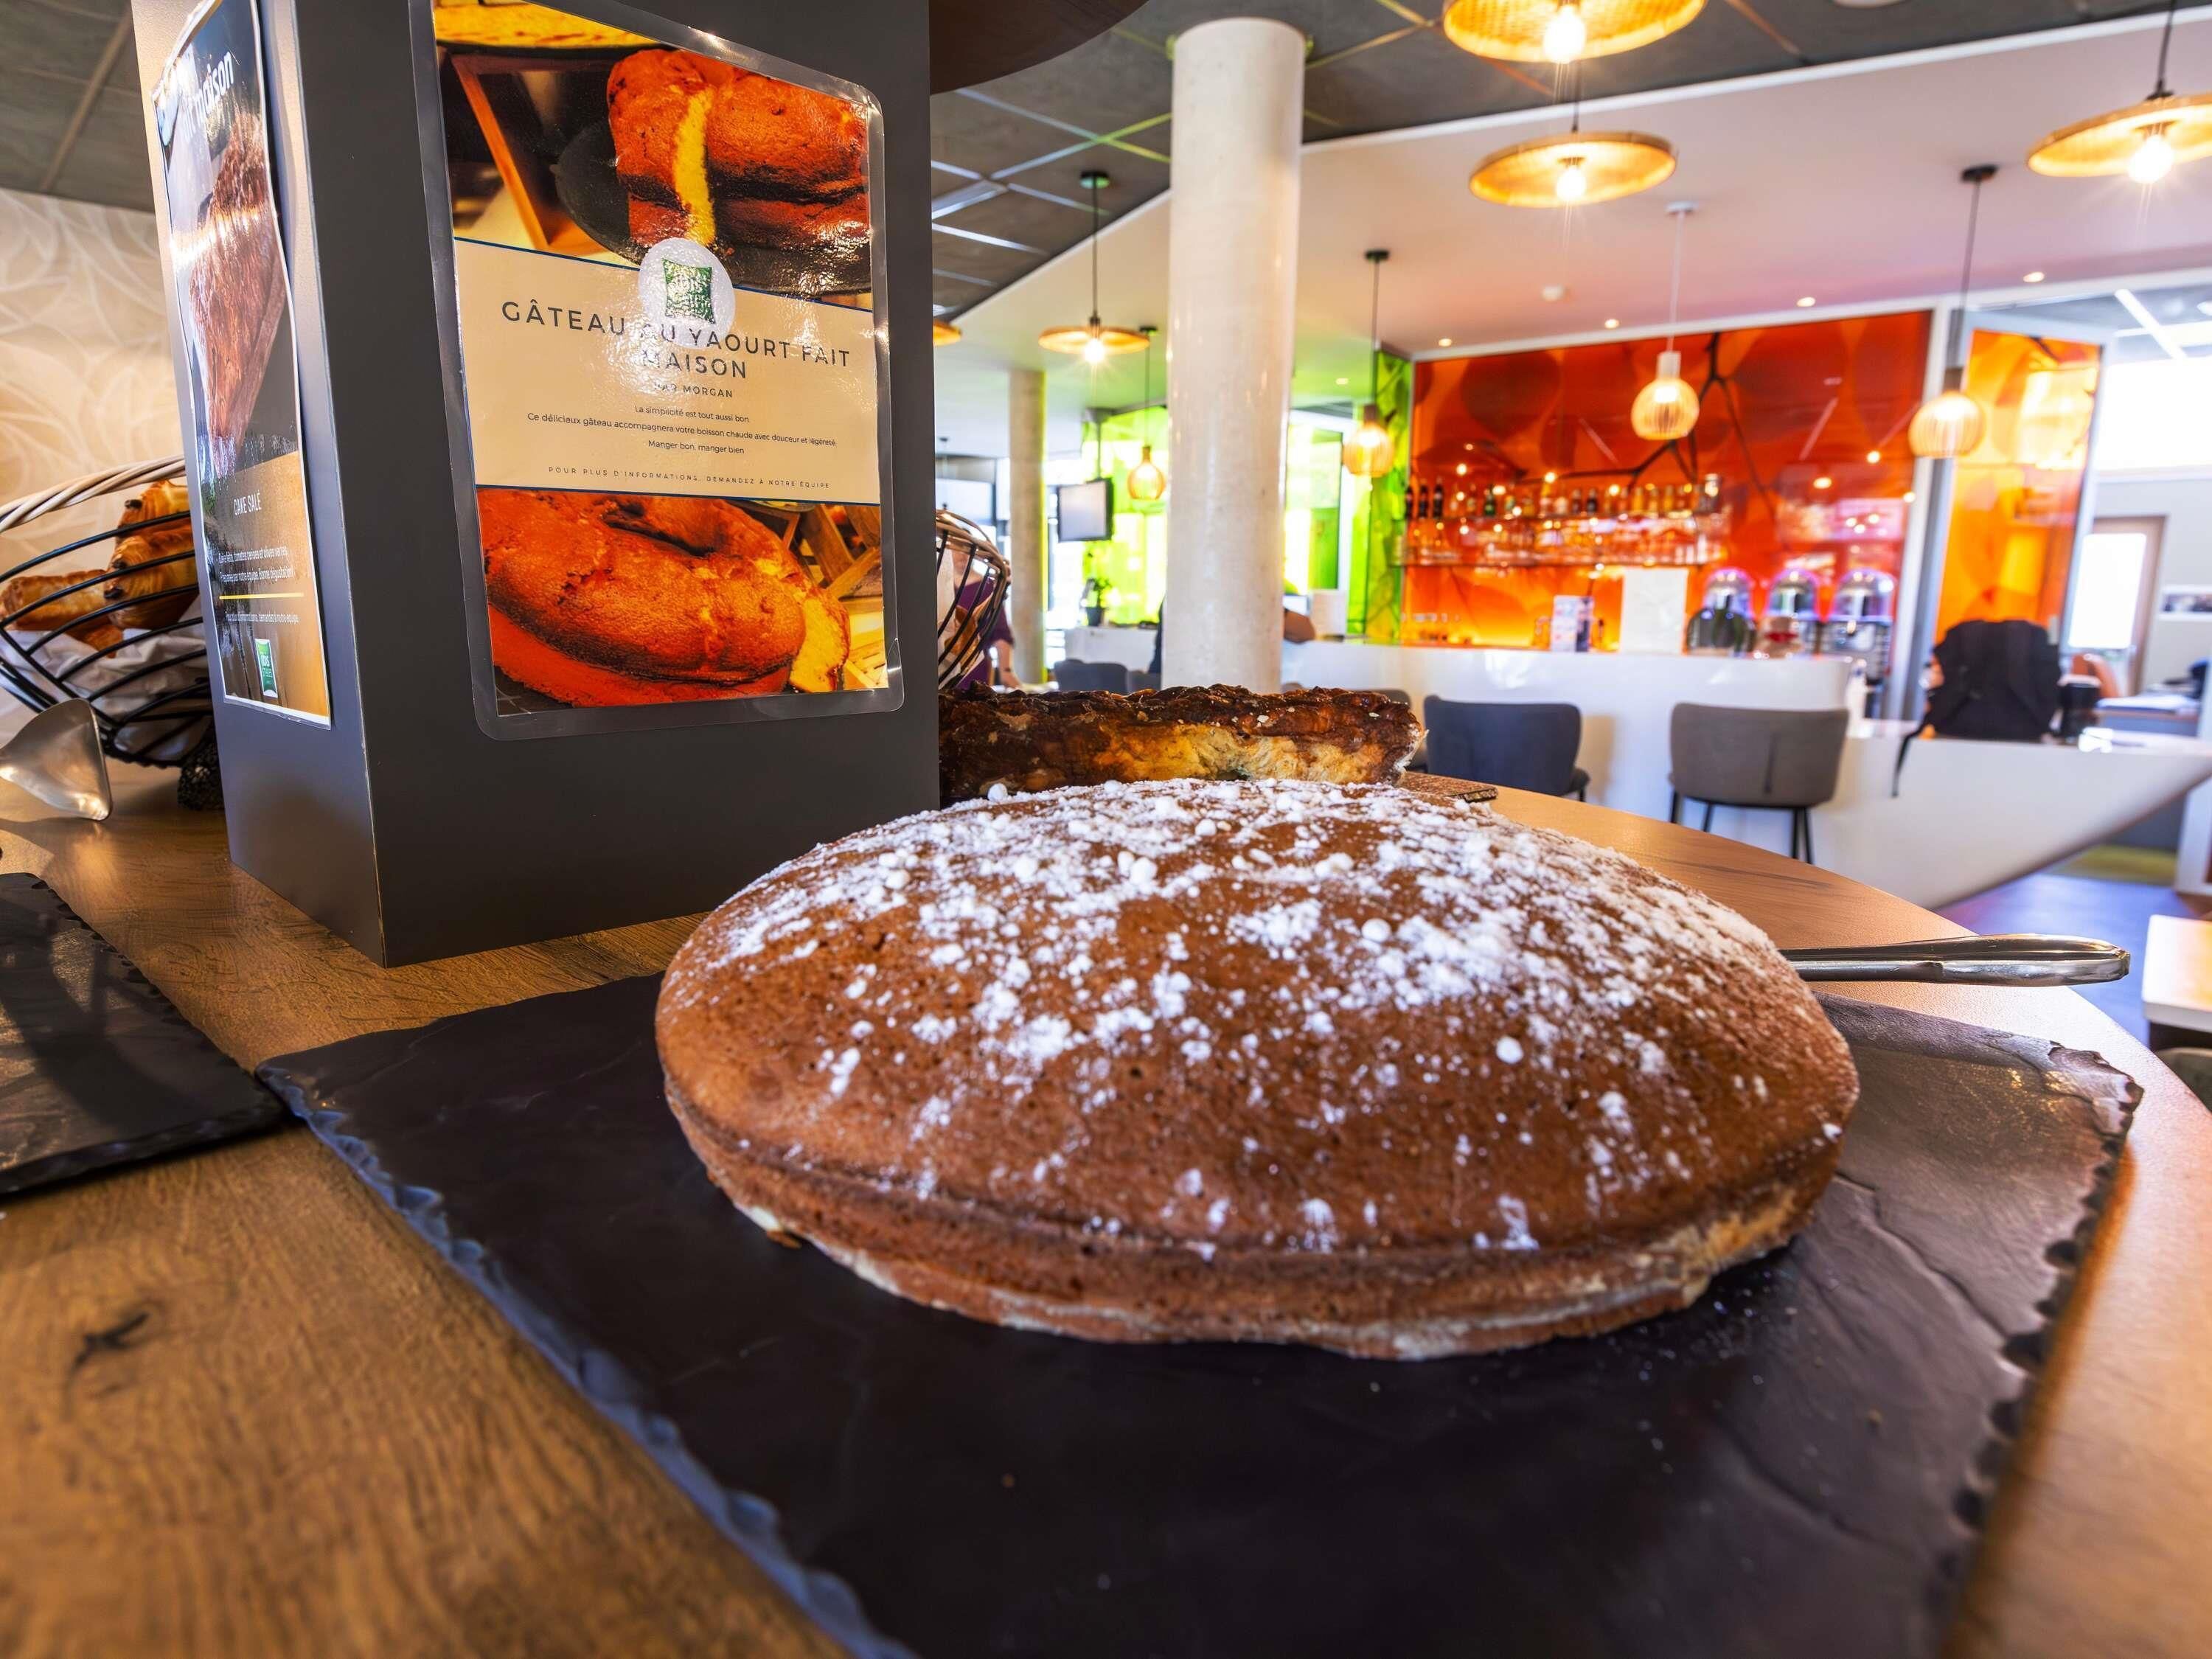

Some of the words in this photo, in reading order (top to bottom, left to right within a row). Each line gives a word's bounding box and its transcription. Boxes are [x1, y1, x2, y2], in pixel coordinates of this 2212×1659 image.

[501, 299, 625, 335] GÂTEAU
[689, 327, 790, 359] YAOURT
[802, 344, 849, 366] FAIT
[642, 349, 746, 378] MAISON
[683, 385, 732, 398] MORGAN
[635, 405, 644, 414] La
[645, 406, 684, 417] simplicité
[698, 411, 714, 420] tout
[527, 412, 540, 421] Ce
[542, 414, 580, 425] délicieux
[583, 417, 612, 427] gâteau
[614, 420, 674, 432] accompagnera
[676, 426, 695, 434] votre
[697, 428, 725, 437] boisson
[726, 430, 753, 439] chaude
[754, 433, 770, 441] avec
[771, 434, 799, 443] douceur
[648, 439, 678, 450] Manger
[698, 444, 728, 454] manger
[728, 445, 745, 453] bien
[549, 466, 577, 474] POUR
[583, 468, 608, 476] PLUS
[706, 476, 754, 484] DEMANDEZ
[233, 495, 248, 516] CAKE
[248, 489, 262, 512] SALÉ
